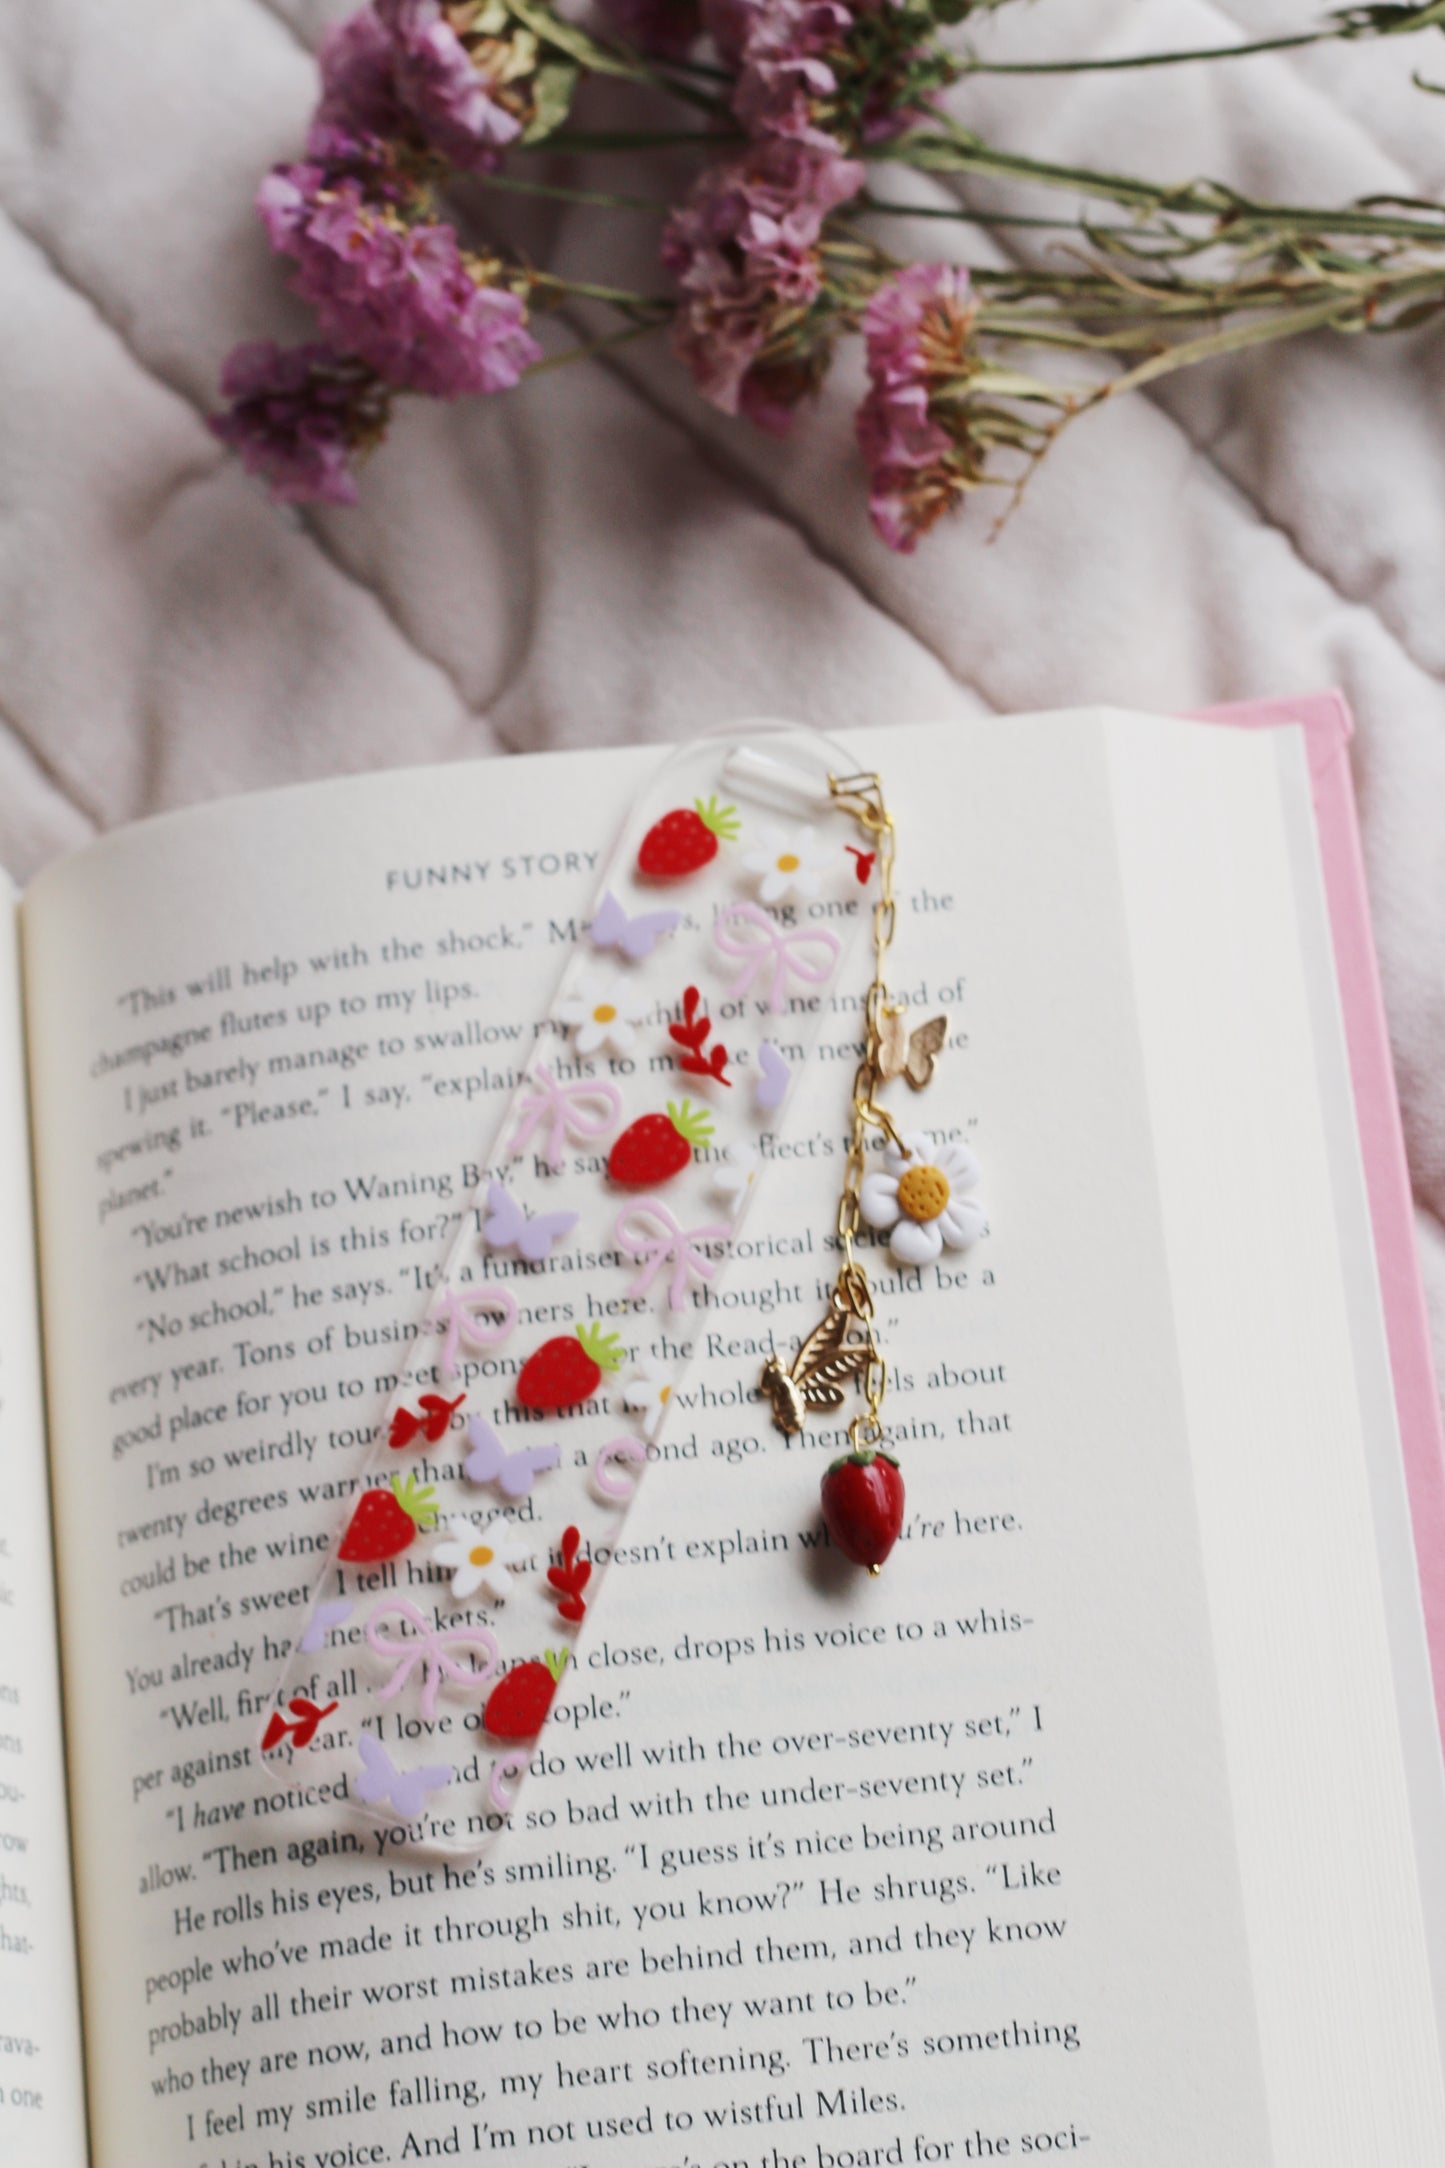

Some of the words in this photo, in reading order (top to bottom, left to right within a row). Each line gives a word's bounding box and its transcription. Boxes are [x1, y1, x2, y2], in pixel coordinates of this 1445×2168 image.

[386, 861, 491, 891] FUNNY
[502, 851, 600, 879] STORY
[117, 988, 176, 1017] “This
[186, 966, 231, 997] will
[242, 956, 298, 986] help
[309, 942, 369, 974] with
[381, 938, 424, 963] the
[437, 922, 532, 956] shock,”
[808, 899, 858, 919] one
[911, 888, 954, 912] the
[219, 1009, 288, 1038] flutes
[297, 999, 331, 1027] up
[340, 994, 367, 1016] to
[375, 986, 416, 1013] my
[425, 978, 480, 1005] lips.
[185, 1057, 261, 1094] barely
[268, 1041, 368, 1069] manage
[378, 1036, 405, 1056] to
[414, 1014, 522, 1050] swallow
[938, 978, 967, 1003] of
[221, 1088, 329, 1128] “Please,”
[364, 1084, 411, 1109] say,
[131, 1212, 209, 1248] “You’re
[215, 1189, 301, 1228] newish
[344, 1172, 453, 1202] Waning
[134, 1259, 209, 1292] “What
[218, 1236, 301, 1277] school
[340, 1225, 390, 1252] this
[399, 1212, 463, 1245] for?”
[109, 1370, 162, 1403] every
[170, 1354, 224, 1392] year.
[233, 1336, 296, 1371] Tons
[691, 1279, 803, 1312] thought
[937, 1267, 969, 1289] be
[138, 1317, 182, 1343] “No
[189, 1286, 285, 1331] school,”
[292, 1283, 323, 1309] he
[332, 1276, 392, 1306] says.
[146, 1462, 181, 1489] I’m
[223, 1431, 318, 1469] weirdly
[676, 1382, 760, 1409] whole
[927, 1365, 1008, 1390] about
[169, 1405, 228, 1442] place
[236, 1392, 271, 1419] for
[279, 1384, 328, 1416] you
[651, 1341, 694, 1362] the
[195, 1489, 289, 1528] degrees
[712, 1437, 767, 1463] ago.
[957, 1411, 1013, 1436] that
[154, 1598, 232, 1634] “That’s
[358, 1556, 396, 1591] tell
[585, 1538, 674, 1566] doesn’t
[685, 1530, 788, 1564] explain
[954, 1511, 1023, 1536] here.
[219, 1542, 257, 1570] the
[266, 1530, 329, 1561] wine
[126, 1667, 164, 1694] You
[171, 1645, 254, 1681] already
[160, 1697, 229, 1731] “Well,
[327, 1669, 358, 1698] all
[588, 1648, 665, 1669] close,
[674, 1635, 755, 1666] drops
[765, 1628, 805, 1652] his
[815, 1623, 887, 1647] voice
[956, 1609, 1035, 1636] whis-
[132, 1769, 165, 1802] per
[171, 1747, 252, 1788] against
[397, 1714, 452, 1739] love
[166, 1806, 184, 1832] “I
[192, 1801, 245, 1828] have
[252, 1773, 349, 1816] noticed
[529, 1751, 566, 1777] do
[576, 1742, 631, 1770] well
[642, 1736, 705, 1766] with
[717, 1733, 762, 1759] the
[772, 1721, 954, 1755] over-seventy
[964, 1706, 1021, 1738] set,”
[138, 1864, 197, 1894] allow.
[202, 1846, 278, 1875] “Then
[287, 1831, 365, 1867] again,
[374, 1809, 455, 1855] you’re
[526, 1809, 556, 1829] so
[568, 1795, 619, 1825] bad
[629, 1788, 694, 1818] with
[705, 1786, 751, 1811] the
[761, 1777, 966, 1809] under-seventy
[977, 1758, 1033, 1788] set.”
[174, 1907, 206, 1935] He
[213, 1895, 264, 1925] rolls
[271, 1888, 310, 1914] his
[318, 1880, 382, 1914] eyes,
[389, 1870, 435, 1898] but
[443, 1860, 495, 1889] he’s
[505, 1852, 617, 1884] smiling.
[661, 1841, 739, 1875] guess
[748, 1834, 785, 1859] it’s
[795, 1831, 854, 1855] nice
[862, 1823, 944, 1853] being
[952, 1808, 1056, 1843] around
[145, 1956, 213, 2004] people
[222, 1940, 308, 1977] who’ve
[320, 1925, 392, 1960] made
[434, 1907, 549, 1944] through
[562, 1902, 621, 1929] shit,
[633, 1901, 686, 1931] you
[698, 1881, 804, 1916] know?”
[819, 1880, 861, 1906] He
[873, 1872, 976, 1904] shrugs.
[986, 1860, 1062, 1890] “Like
[150, 2002, 241, 2054] probably
[252, 1992, 280, 2023] all
[290, 1987, 353, 2016] their
[362, 1976, 438, 2005] worst
[450, 1959, 573, 1995] mistakes
[586, 1958, 630, 1980] are
[641, 1939, 743, 1975] behind
[755, 1936, 837, 1964] them,
[849, 1925, 903, 1955] and
[914, 1922, 976, 1954] they
[987, 1917, 1067, 1943] know
[150, 2067, 195, 2097] who
[202, 2058, 251, 2086] they
[308, 2040, 370, 2066] now,
[380, 2024, 431, 2056] and
[442, 2021, 503, 2049] how
[553, 2009, 587, 2035] be
[597, 2001, 660, 2030] who
[672, 1996, 732, 2028] they
[743, 1991, 815, 2018] want
[864, 1976, 917, 2007] be.”
[206, 2104, 245, 2137] feel
[256, 2104, 293, 2131] my
[306, 2087, 377, 2120] smile
[388, 2075, 486, 2108] falling,
[501, 2073, 543, 2099] my
[557, 2061, 633, 2089] heart
[646, 2048, 791, 2077] softening.
[802, 2032, 909, 2064] There’s
[923, 2020, 1082, 2055] something
[315, 2143, 391, 2168] voice.
[401, 2126, 459, 2158] And
[473, 2122, 516, 2151] I’m
[528, 2120, 575, 2144] not
[586, 2106, 654, 2137] used
[703, 2092, 803, 2127] wistful
[816, 2088, 906, 2117] Miles.
[914, 2135, 954, 2161] for
[966, 2130, 1011, 2157] the
[1021, 2124, 1091, 2152] soci-
